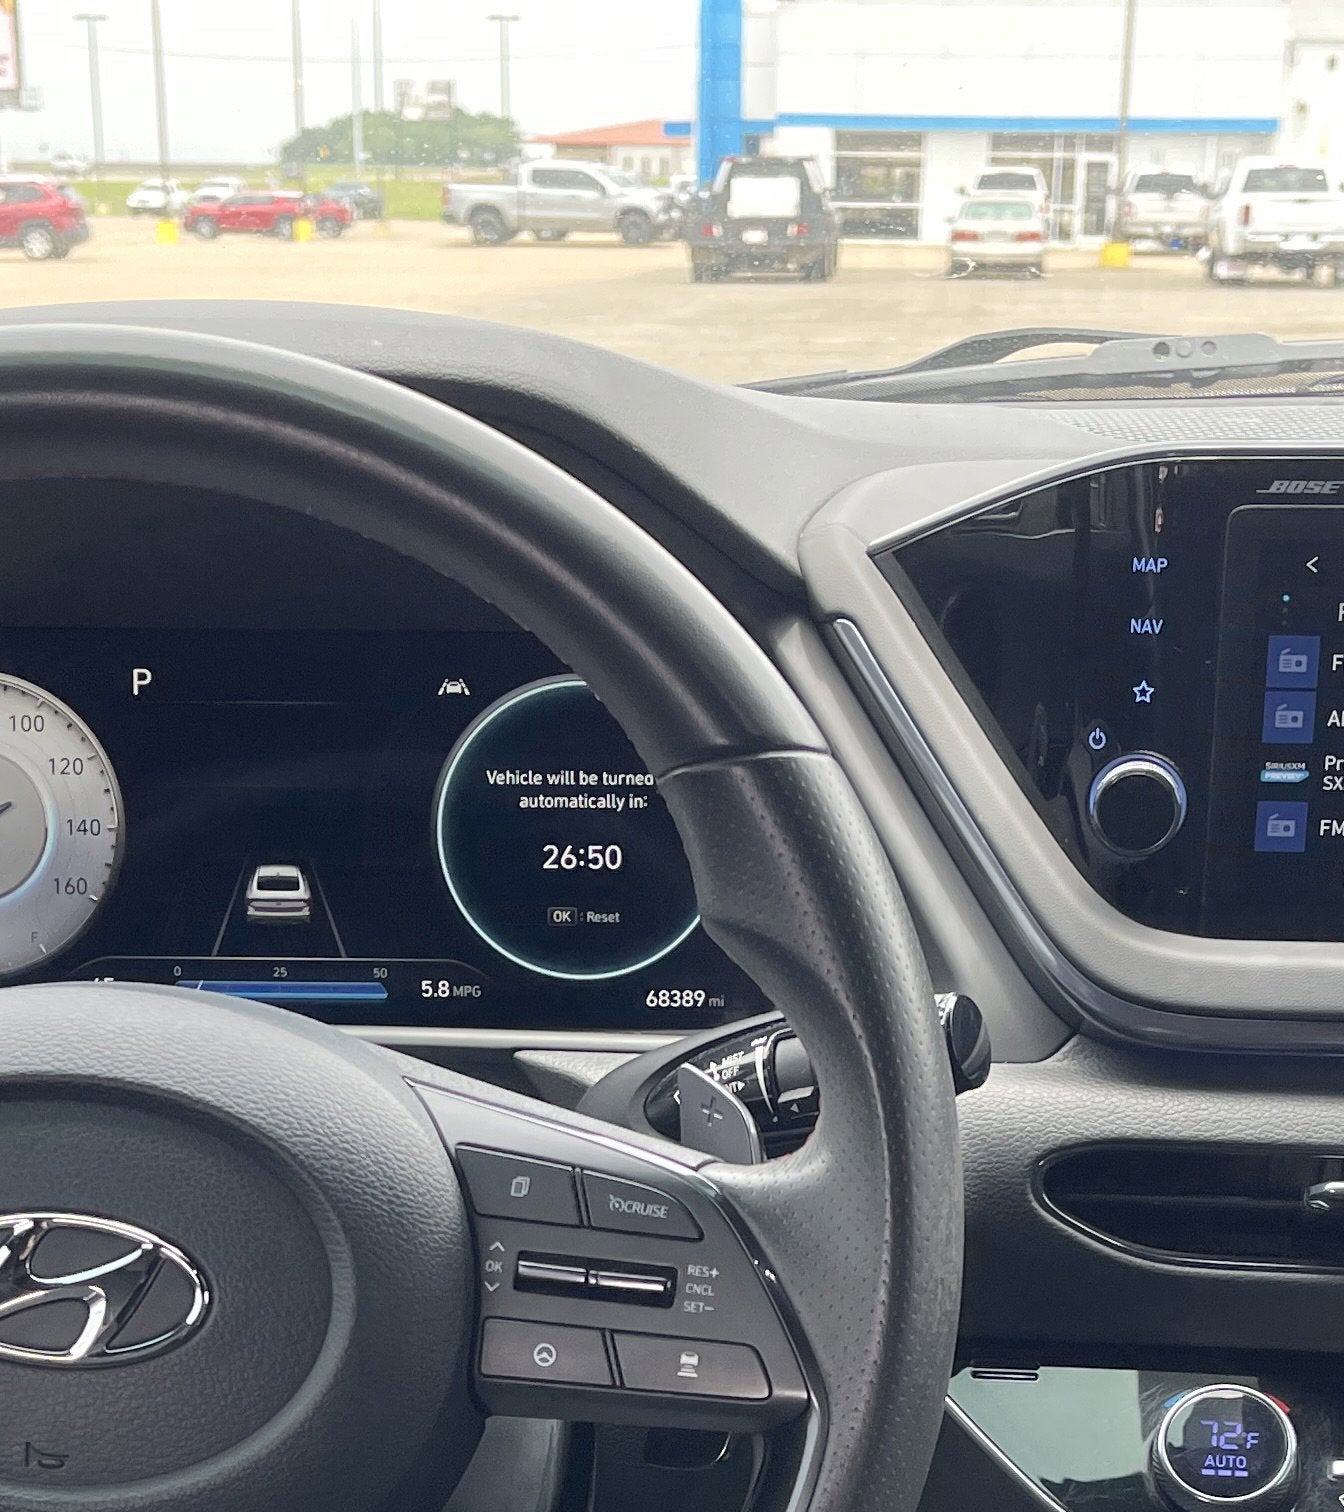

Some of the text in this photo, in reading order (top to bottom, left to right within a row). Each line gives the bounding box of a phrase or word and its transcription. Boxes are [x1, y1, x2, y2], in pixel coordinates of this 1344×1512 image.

[1132, 556, 1168, 574] MAP
[1130, 618, 1164, 636] NAV
[131, 668, 152, 695] P
[9, 714, 45, 733] 100
[49, 757, 84, 776] 120
[486, 769, 543, 786] Vehicle
[547, 770, 576, 786] will
[579, 770, 599, 786] be
[519, 794, 649, 812] automatically in:
[66, 818, 102, 836] 140
[542, 844, 623, 870] 26:50
[54, 876, 88, 895] 160
[552, 910, 620, 924] OK Reset
[31, 931, 39, 943] F
[173, 965, 182, 978] 0
[272, 966, 288, 979] 25
[372, 967, 388, 980] 50
[420, 980, 482, 999] 5.8 MPG
[645, 989, 725, 1008] 68389 mi
[721, 1066, 740, 1080] OFF
[624, 1202, 668, 1218] CRUISE
[485, 1259, 503, 1274] OK
[685, 1281, 715, 1298] CNCL
[1204, 1454, 1247, 1469] AUTO
